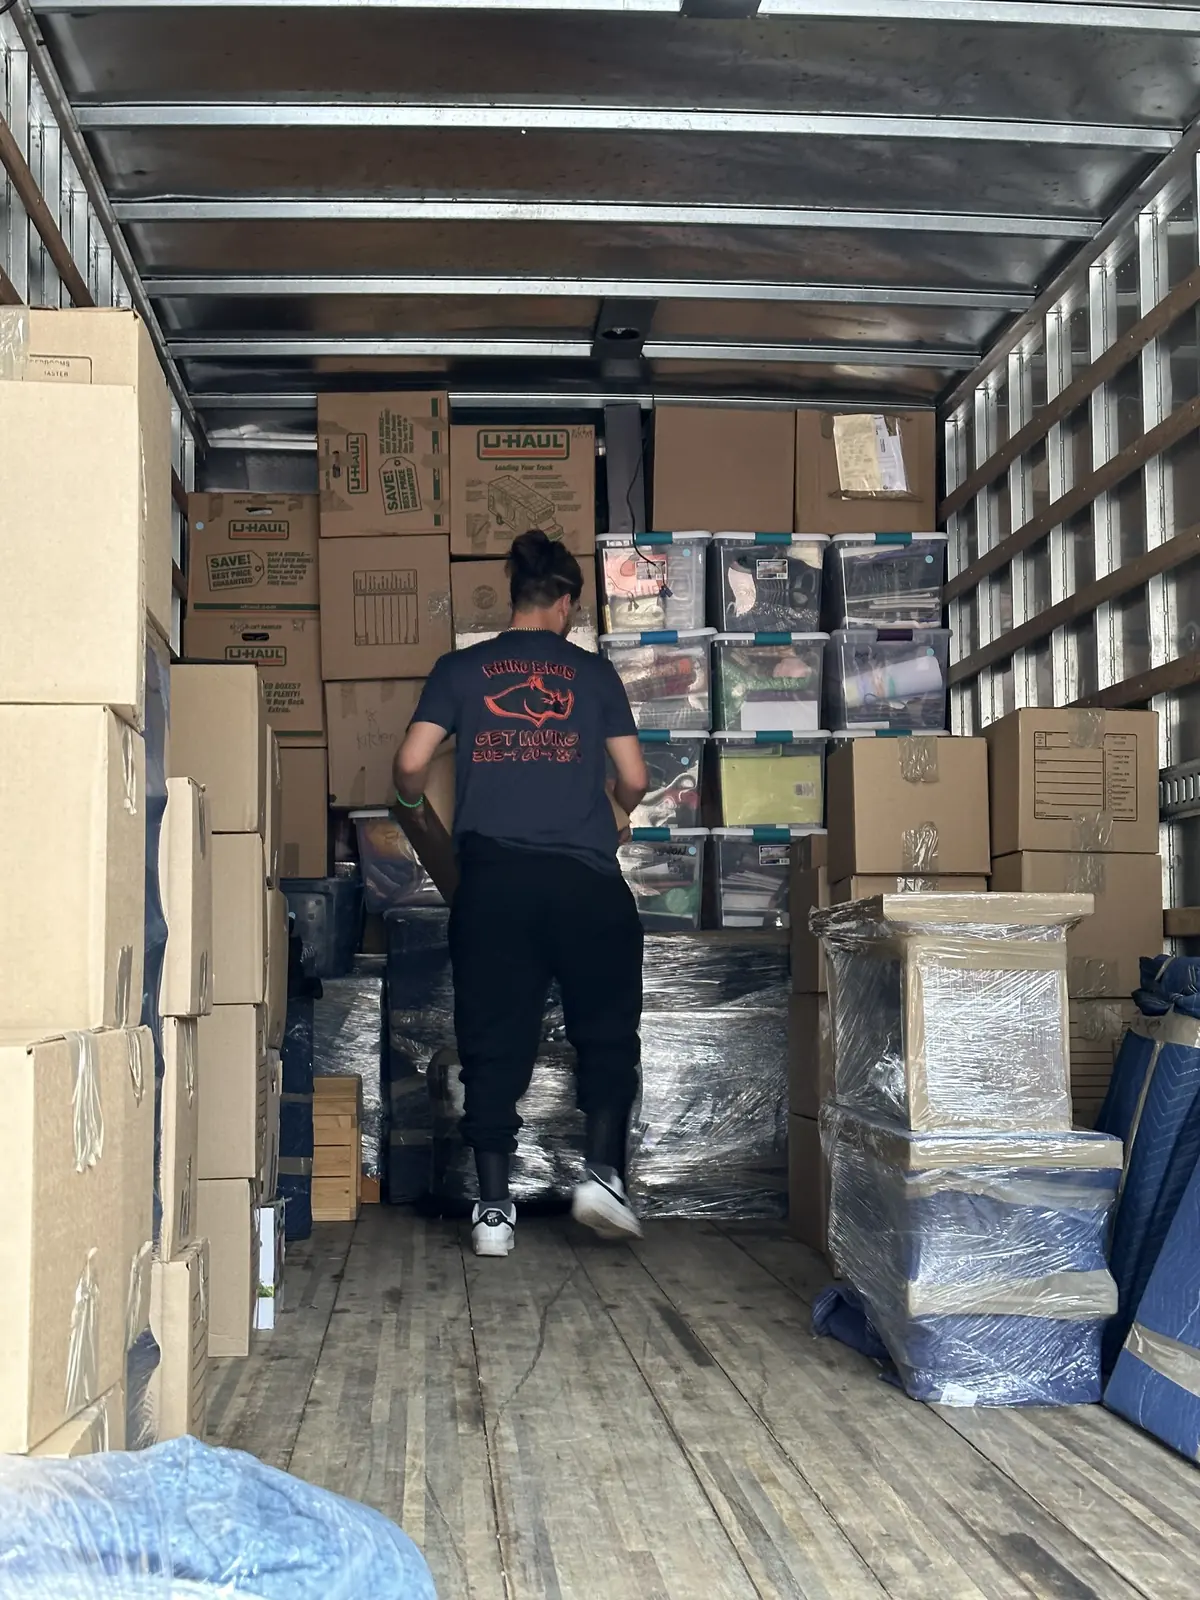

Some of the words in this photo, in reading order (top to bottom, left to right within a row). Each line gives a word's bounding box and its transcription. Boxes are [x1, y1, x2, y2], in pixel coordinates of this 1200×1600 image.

[484, 434, 564, 448] U-HAUL
[382, 470, 398, 511] SAVE!
[232, 523, 286, 533] U-HAUL
[210, 553, 251, 568] SAVE!
[229, 649, 283, 659] U-HAUL
[482, 659, 530, 679] RHINO
[475, 729, 517, 747] GET
[519, 728, 580, 748] MOVING
